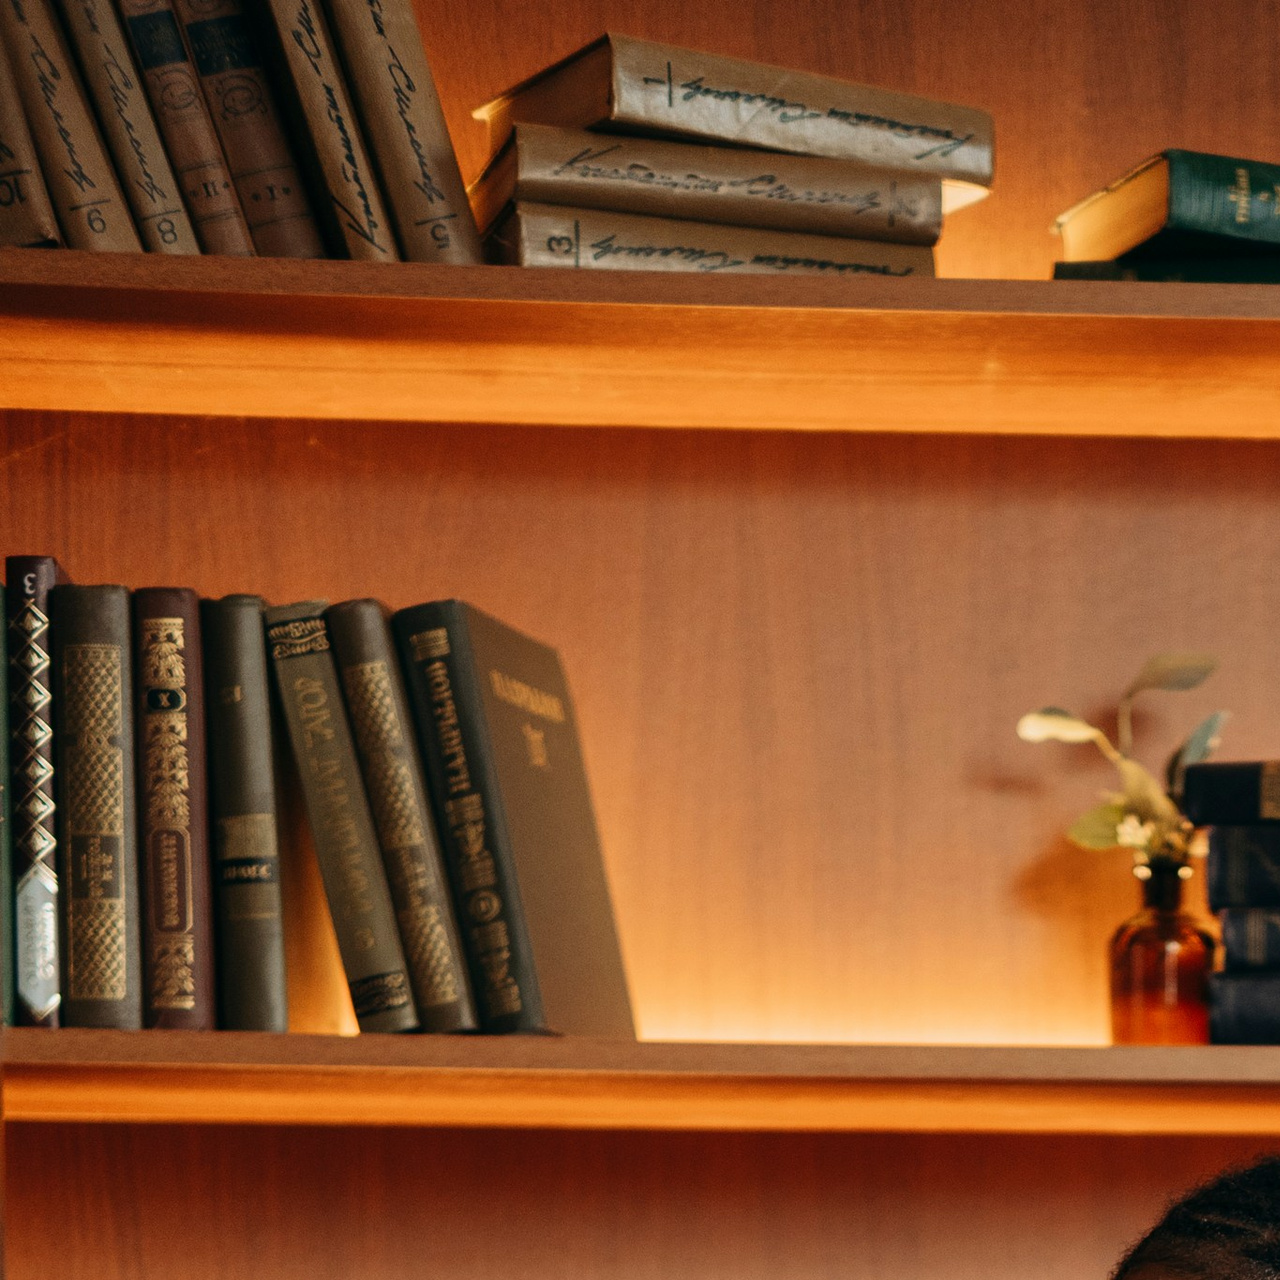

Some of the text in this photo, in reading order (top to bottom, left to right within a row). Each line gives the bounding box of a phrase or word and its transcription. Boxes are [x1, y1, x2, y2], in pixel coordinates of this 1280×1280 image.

[157, 218, 178, 245] 8
[547, 235, 573, 254] 3
[22, 571, 38, 597] 3
